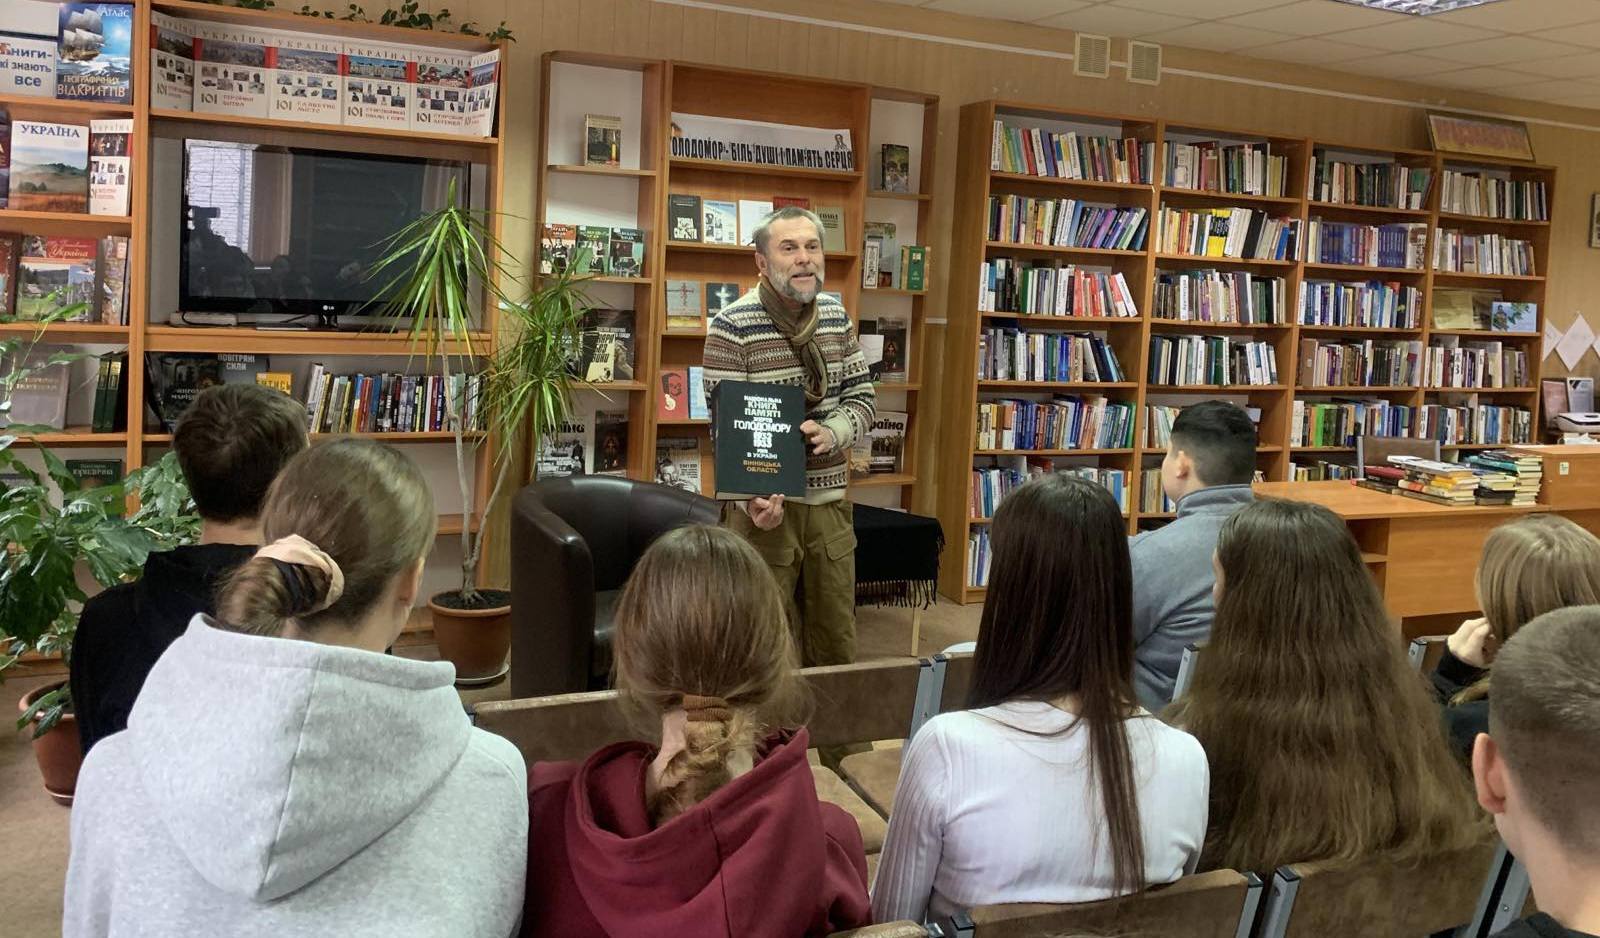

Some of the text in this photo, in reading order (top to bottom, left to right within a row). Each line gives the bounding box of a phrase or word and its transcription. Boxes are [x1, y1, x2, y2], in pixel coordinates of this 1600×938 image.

[203, 31, 265, 44] УКРАЇНА
[278, 39, 338, 52] УКРАЇНА
[348, 47, 407, 60] УКРАЇНА
[11, 61, 52, 73] знають
[417, 55, 472, 67] УКРАЇНА
[14, 75, 42, 87] все
[57, 84, 126, 98] ВІДКРИТТІВ
[201, 93, 218, 105] 101
[276, 99, 292, 111] 101
[348, 106, 363, 117] 101
[416, 112, 431, 123] 101
[20, 124, 81, 138] УКРАЇНА
[731, 142, 753, 162] БІЛЬ
[755, 144, 778, 165] ДУШІ
[747, 401, 778, 411] КНИГА
[733, 420, 792, 434] ГОЛОДОМОРУ
